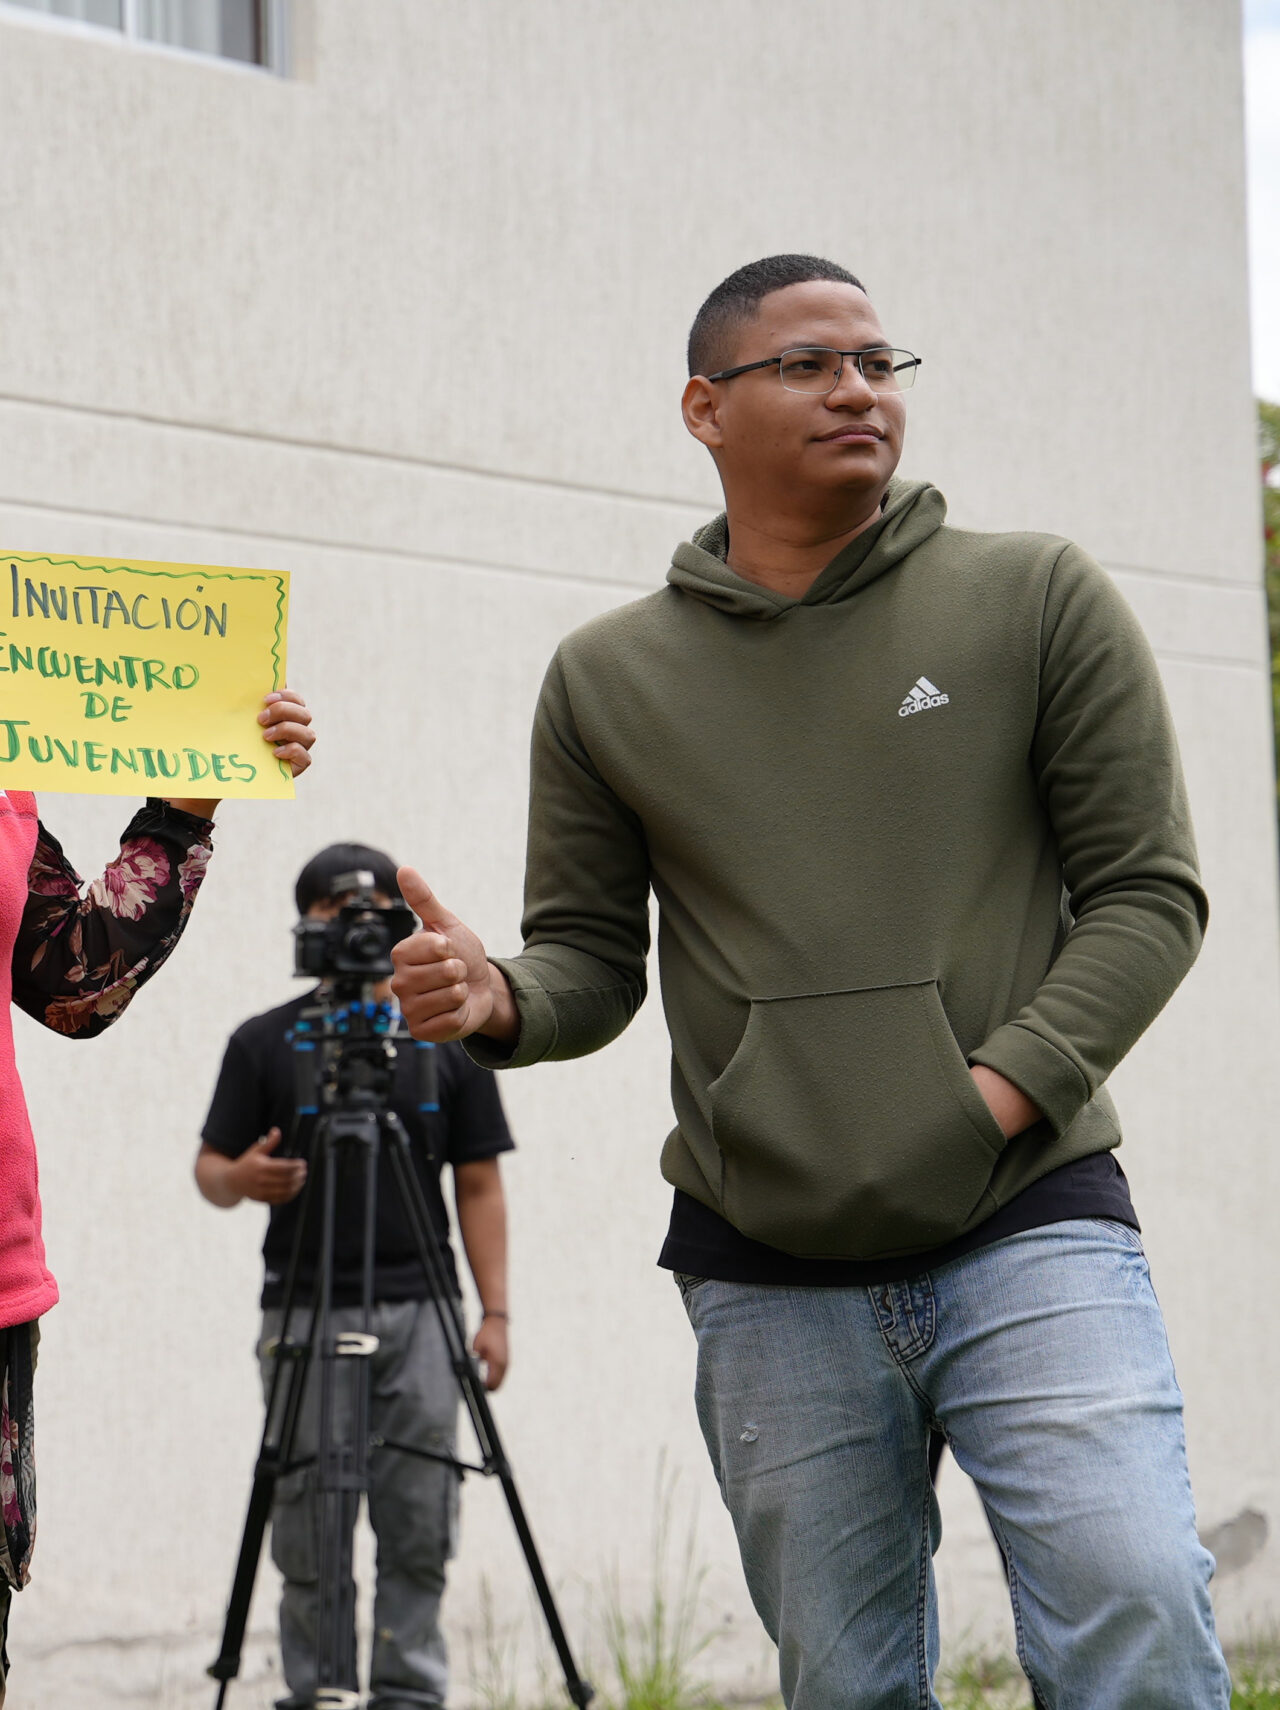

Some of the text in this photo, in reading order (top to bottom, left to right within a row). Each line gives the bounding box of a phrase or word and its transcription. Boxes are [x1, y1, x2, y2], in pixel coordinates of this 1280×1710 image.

[10, 564, 227, 638] INVITACIÓN
[80, 691, 133, 722] DE
[898, 693, 950, 717] adidas
